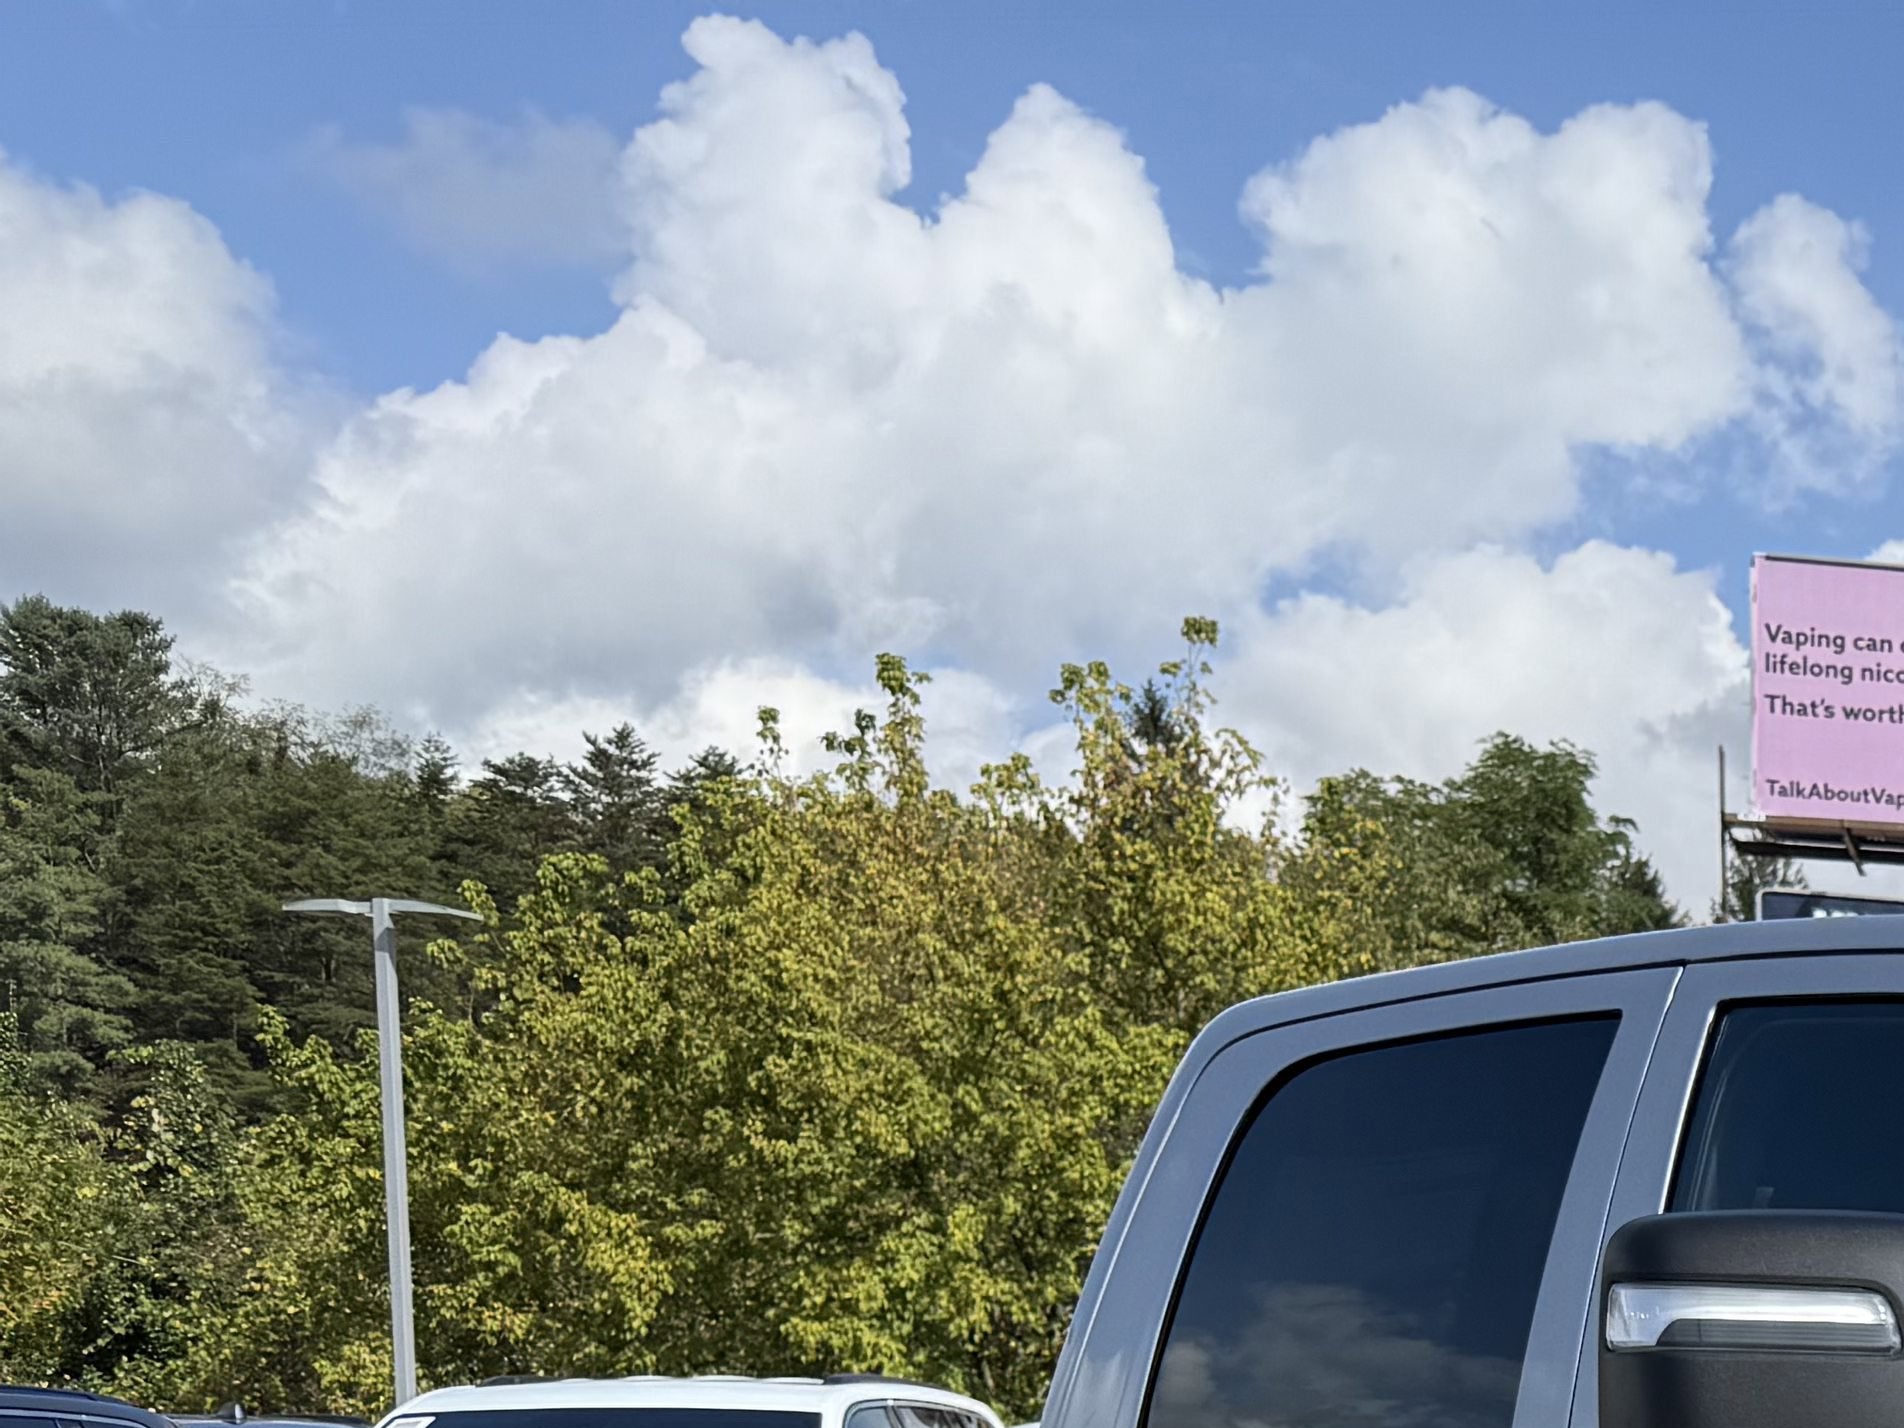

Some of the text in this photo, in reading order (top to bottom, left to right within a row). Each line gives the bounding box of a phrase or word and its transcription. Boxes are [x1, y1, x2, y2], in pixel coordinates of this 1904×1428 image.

[1764, 623, 1846, 655] Vaping
[1853, 636, 1893, 653] can
[1765, 652, 1853, 685] lifelong
[1764, 694, 1836, 719] That's
